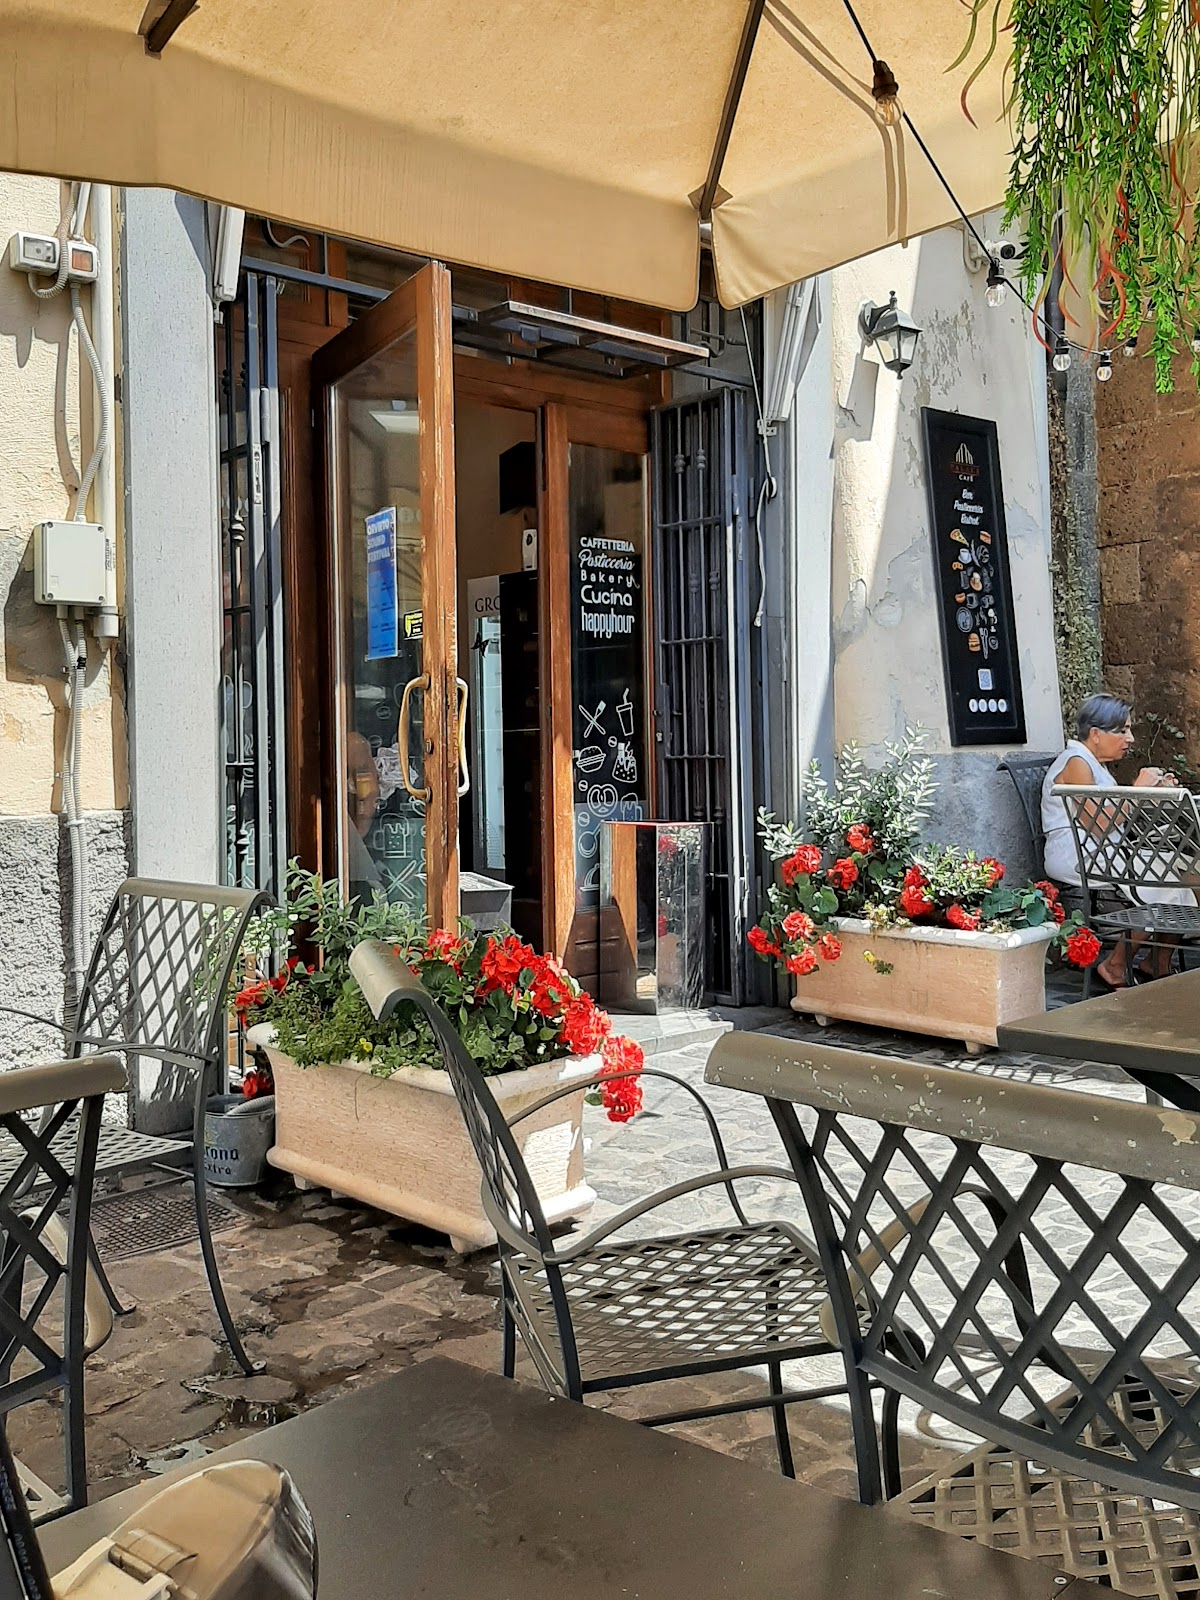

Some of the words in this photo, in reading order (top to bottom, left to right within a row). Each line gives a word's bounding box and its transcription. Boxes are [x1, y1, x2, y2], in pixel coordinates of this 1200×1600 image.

[367, 518, 389, 536] ORVIETO
[367, 533, 386, 550] SOUND
[580, 536, 635, 553] CAFFETTERIA
[578, 549, 635, 571] Pasticceria
[580, 569, 641, 590] Bakery
[580, 584, 633, 606] Cucina
[581, 605, 636, 639] happyhour
